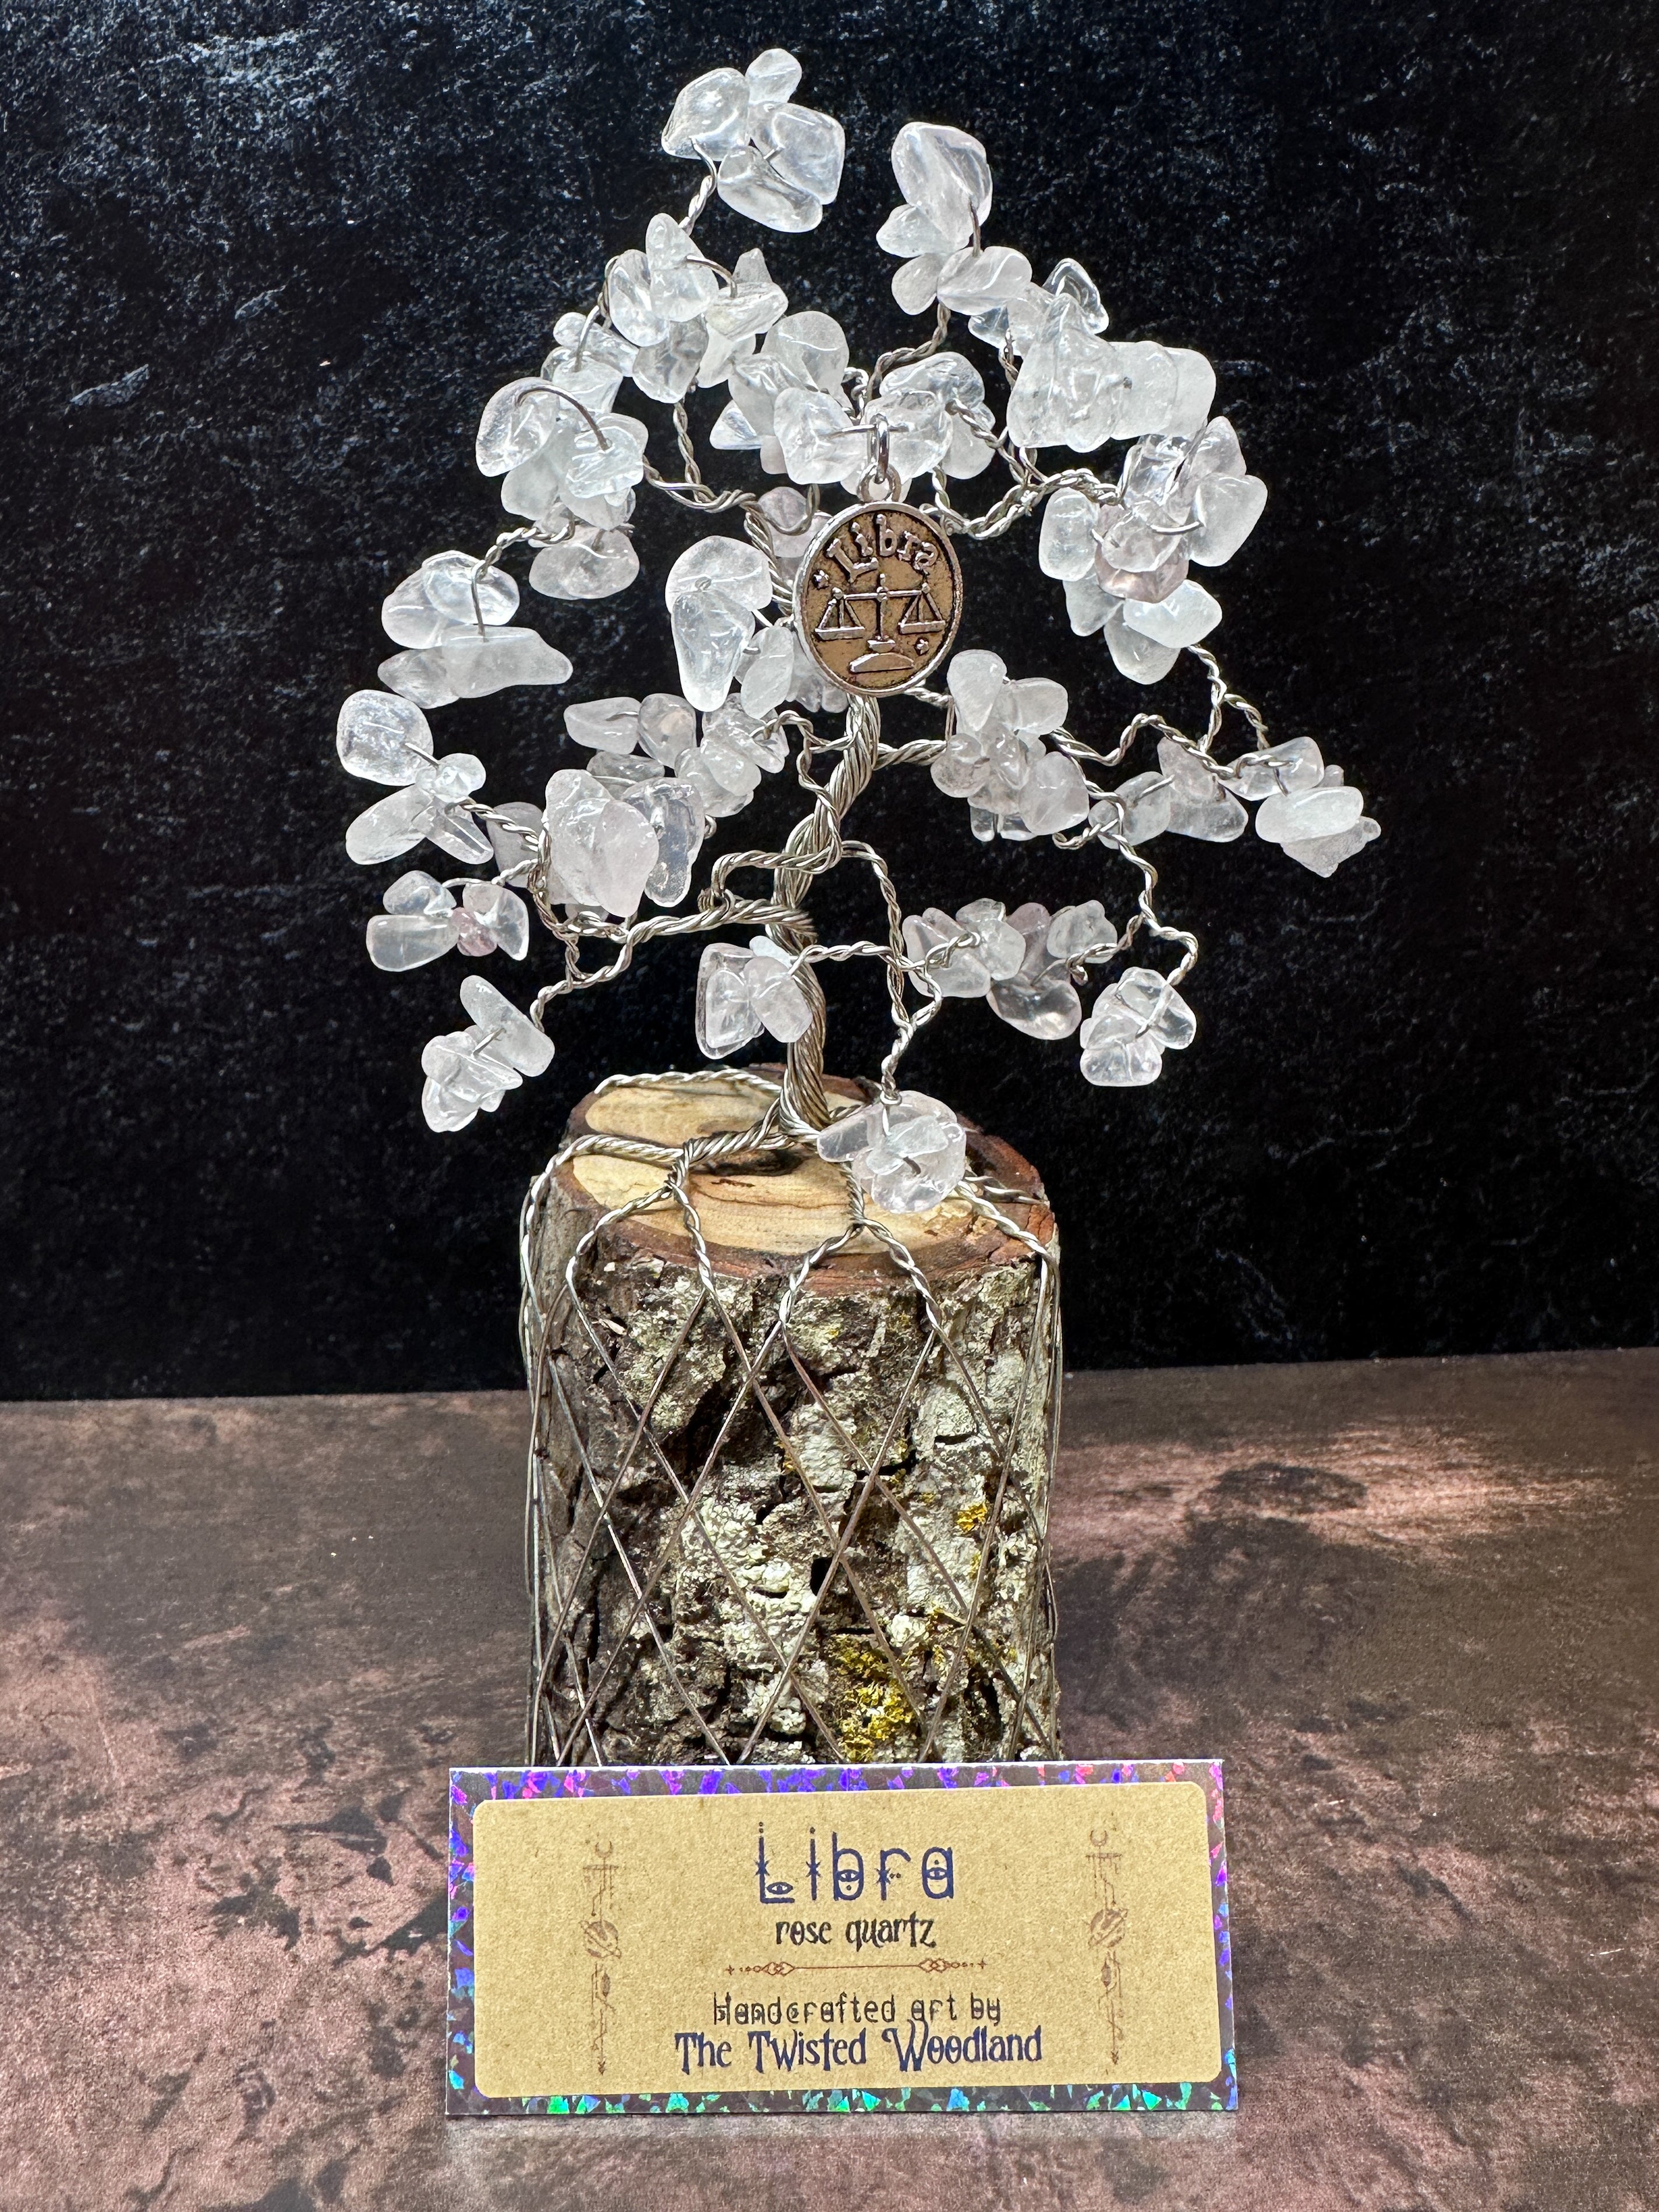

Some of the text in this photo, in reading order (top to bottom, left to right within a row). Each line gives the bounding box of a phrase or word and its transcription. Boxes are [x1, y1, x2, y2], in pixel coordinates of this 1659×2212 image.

[826, 513, 939, 583] Libra
[755, 1821, 954, 1903] Libra
[776, 1911, 936, 1952] rose quartz
[713, 1991, 1001, 2026] Handcrafted art by
[674, 2019, 1042, 2075] The Twisted Woodland
